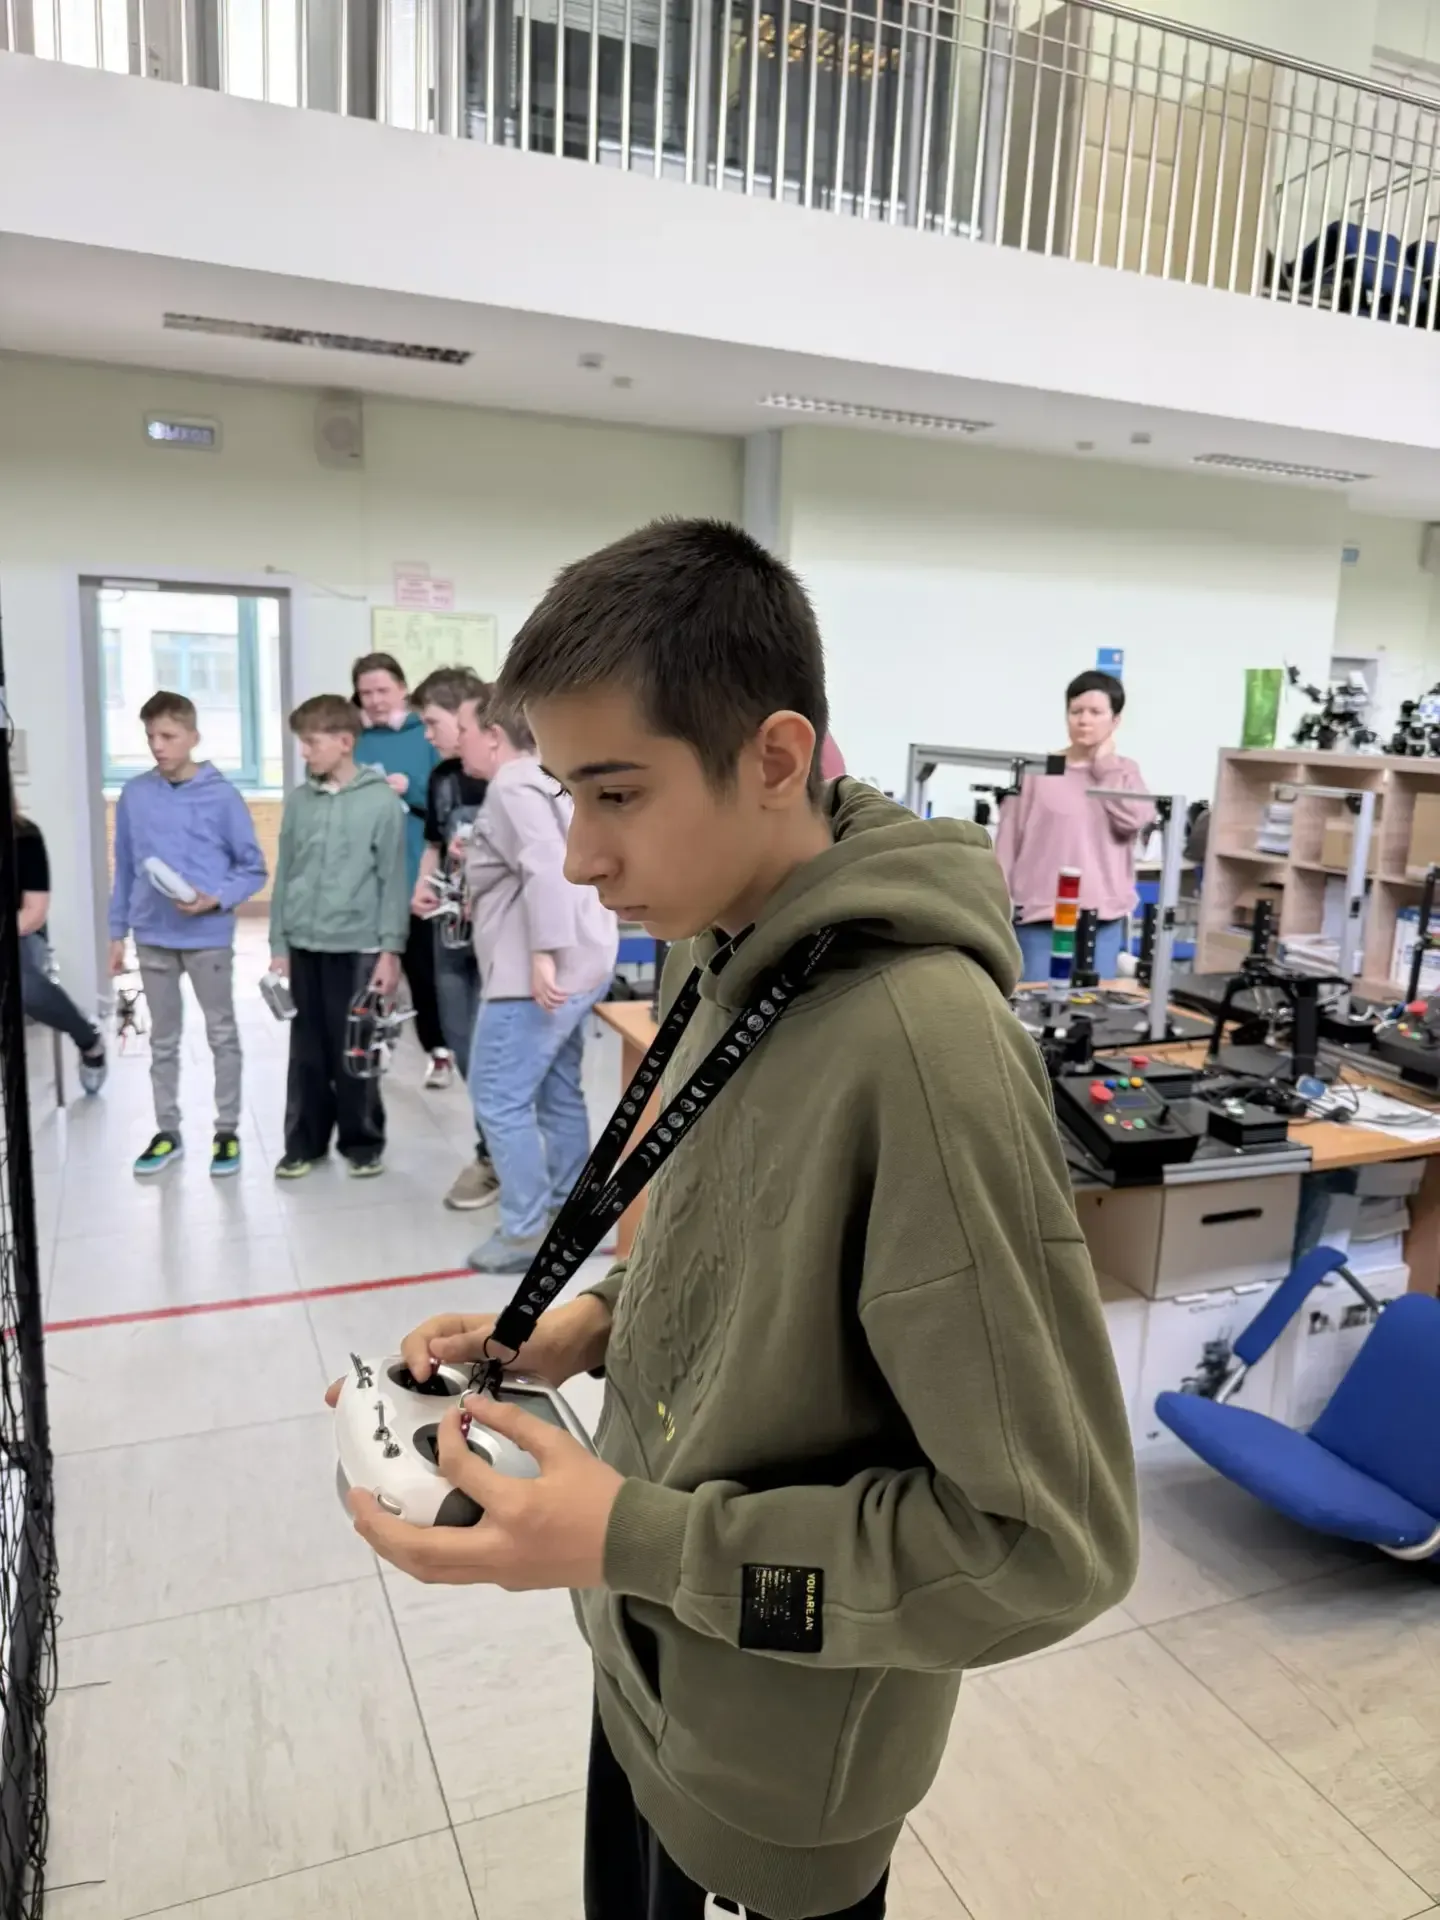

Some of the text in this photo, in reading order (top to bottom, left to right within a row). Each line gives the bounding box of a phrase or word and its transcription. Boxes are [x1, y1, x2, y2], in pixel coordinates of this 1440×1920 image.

[805, 1573, 816, 1631] YOU ARE AN
